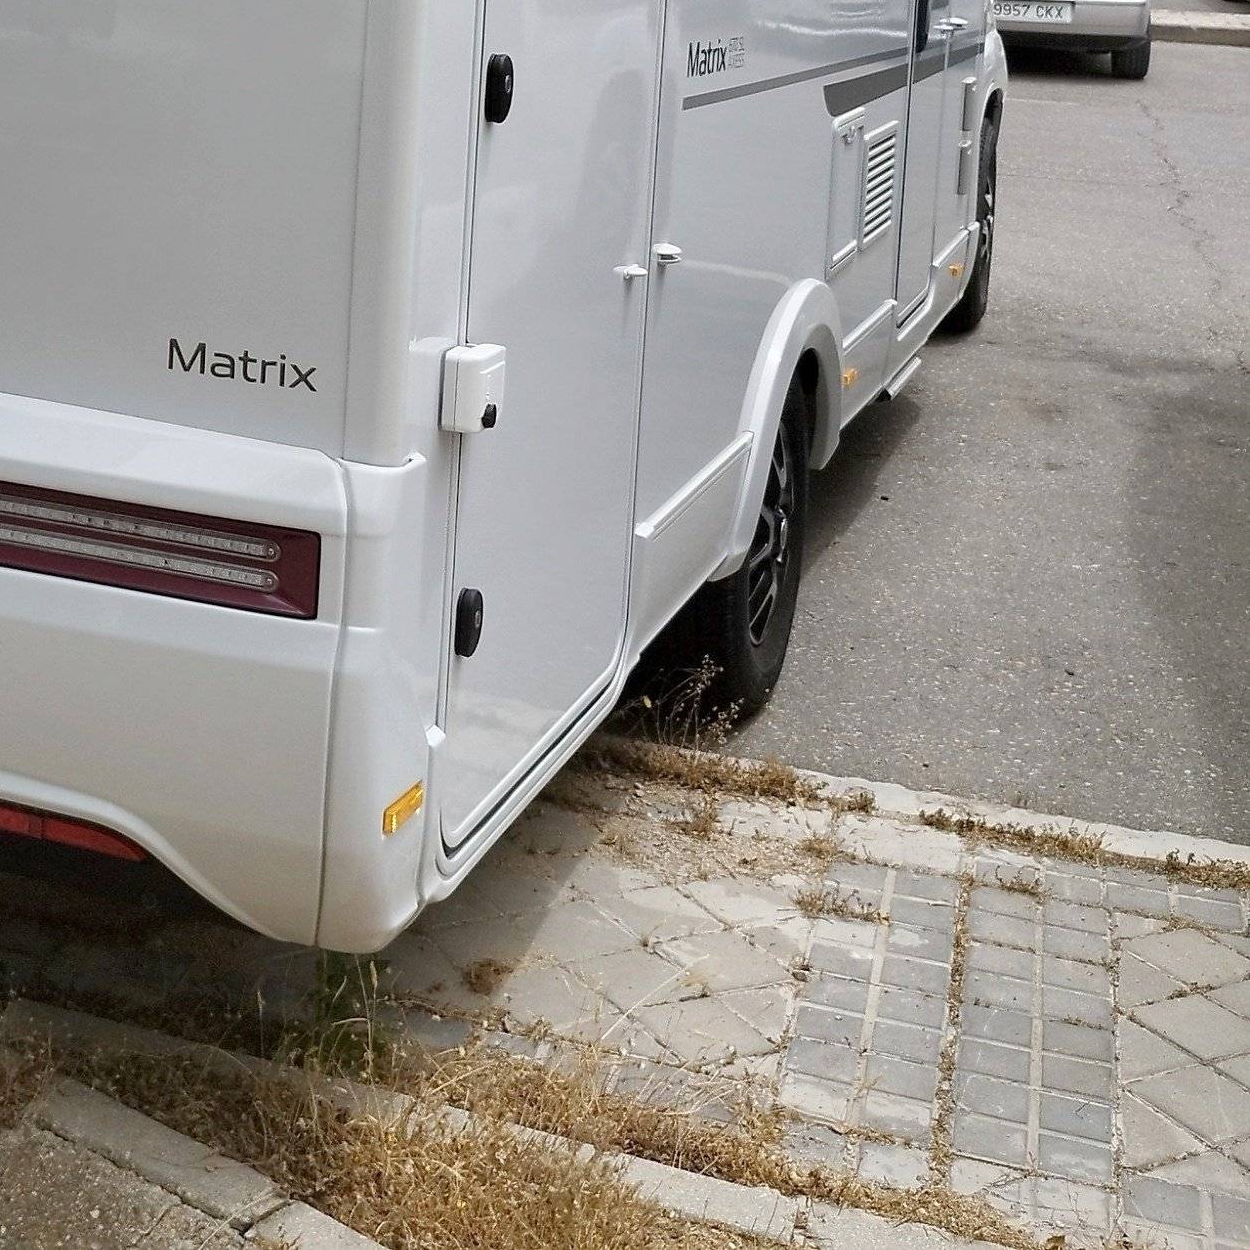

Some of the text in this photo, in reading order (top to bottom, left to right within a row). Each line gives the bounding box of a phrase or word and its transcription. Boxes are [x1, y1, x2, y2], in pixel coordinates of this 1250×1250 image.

[993, 2, 1064, 19] 9957 CKX
[686, 38, 727, 78] Matrix
[167, 337, 318, 393] Matrix
